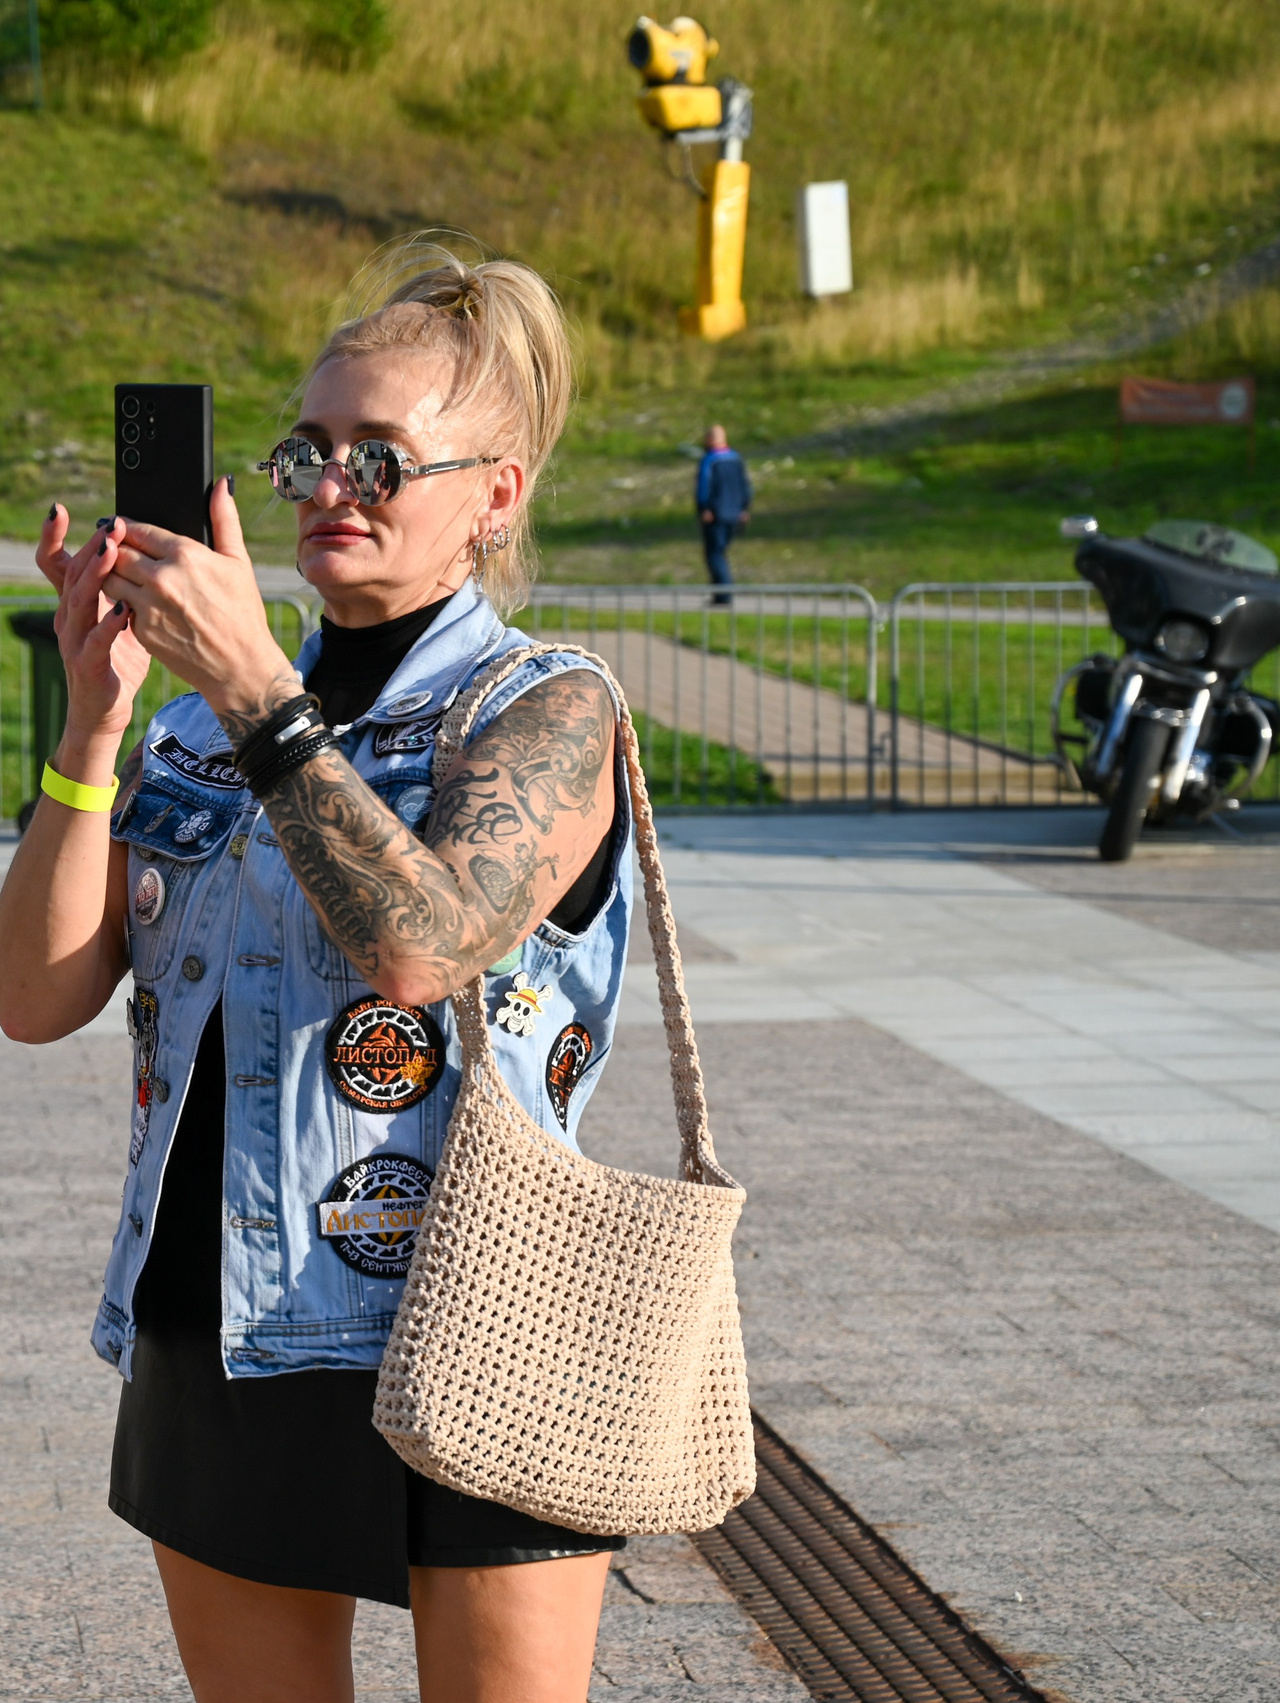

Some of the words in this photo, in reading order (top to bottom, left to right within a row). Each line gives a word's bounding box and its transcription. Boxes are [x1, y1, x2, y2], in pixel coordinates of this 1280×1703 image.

[333, 1046, 438, 1068] ЛИСТОПАД
[339, 1080, 388, 1109] САМАРСКАЯ
[389, 1084, 429, 1109] ОБЛАСТЬ
[342, 1159, 433, 1190] БАЙКРОКФЕСТ
